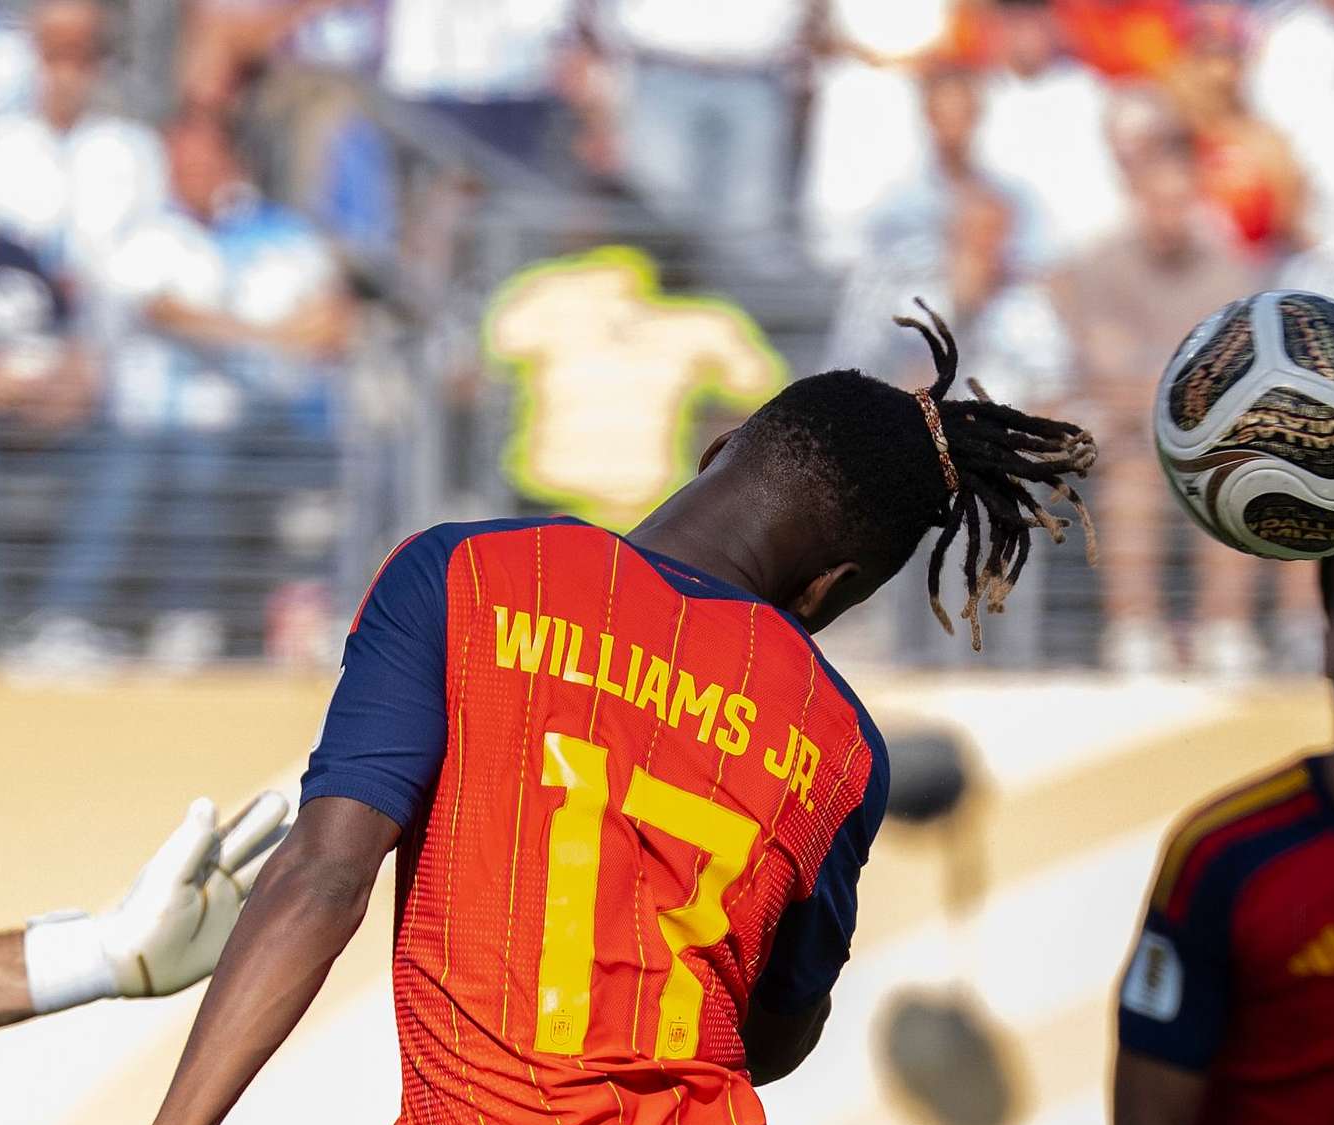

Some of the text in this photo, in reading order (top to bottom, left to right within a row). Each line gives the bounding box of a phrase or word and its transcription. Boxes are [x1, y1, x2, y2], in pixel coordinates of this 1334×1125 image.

[493, 605, 824, 813] WILLIAMS JR.
[533, 731, 761, 1061] 17
